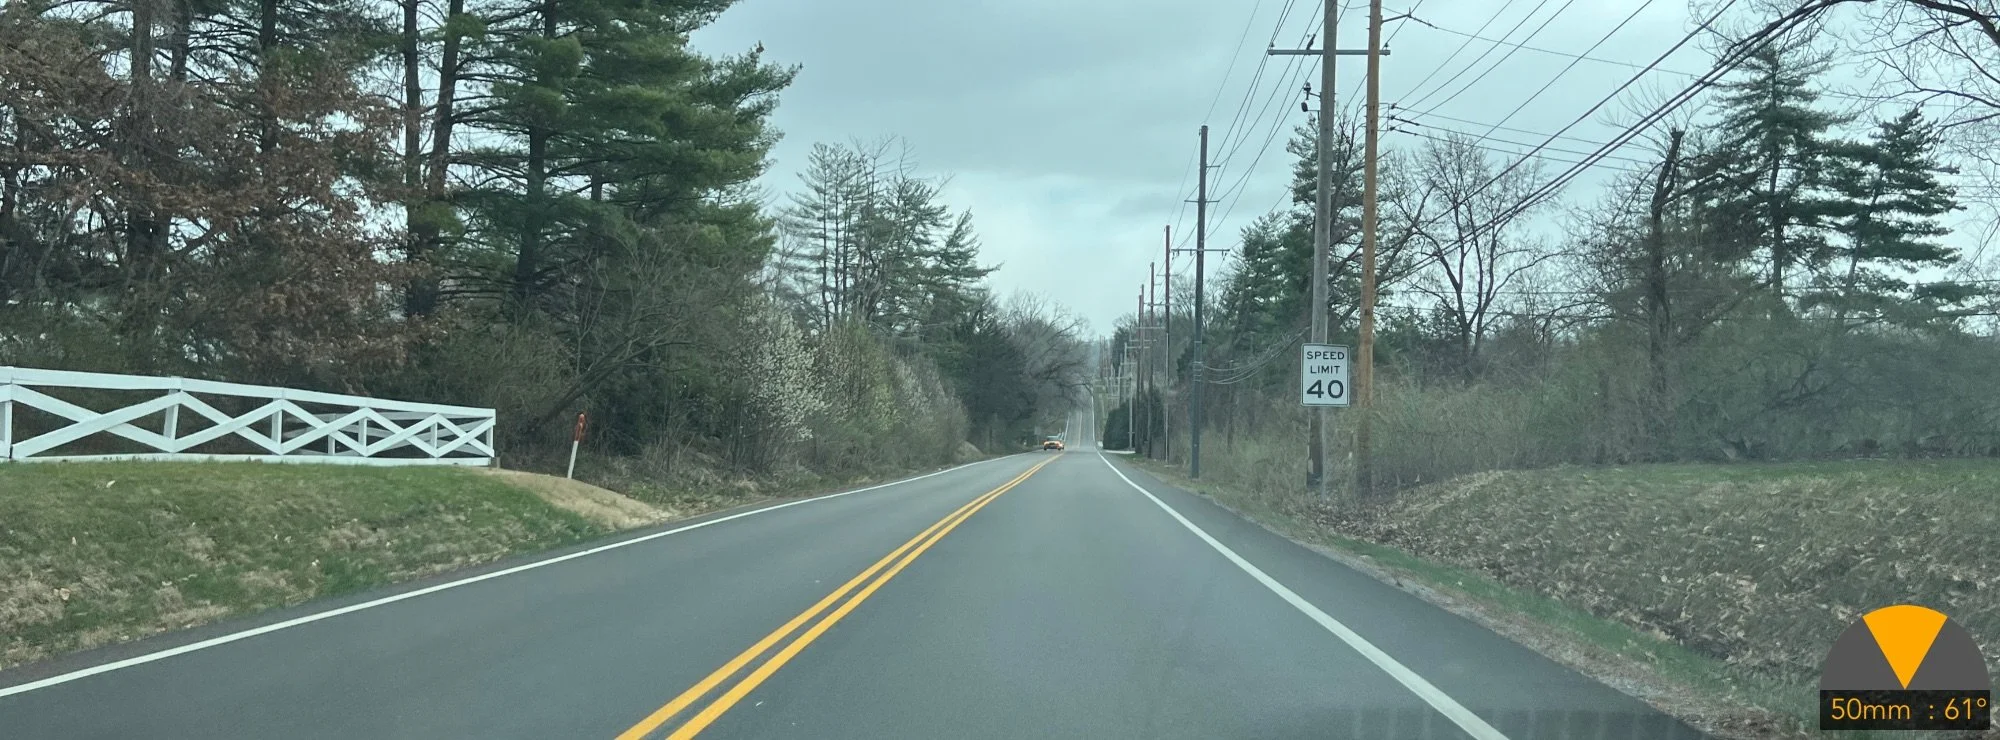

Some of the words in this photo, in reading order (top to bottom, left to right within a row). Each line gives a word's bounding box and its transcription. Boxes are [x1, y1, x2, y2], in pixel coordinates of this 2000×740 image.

[1306, 350, 1345, 360] SPEED
[1310, 365, 1341, 374] LIMIT
[1306, 379, 1344, 399] 40
